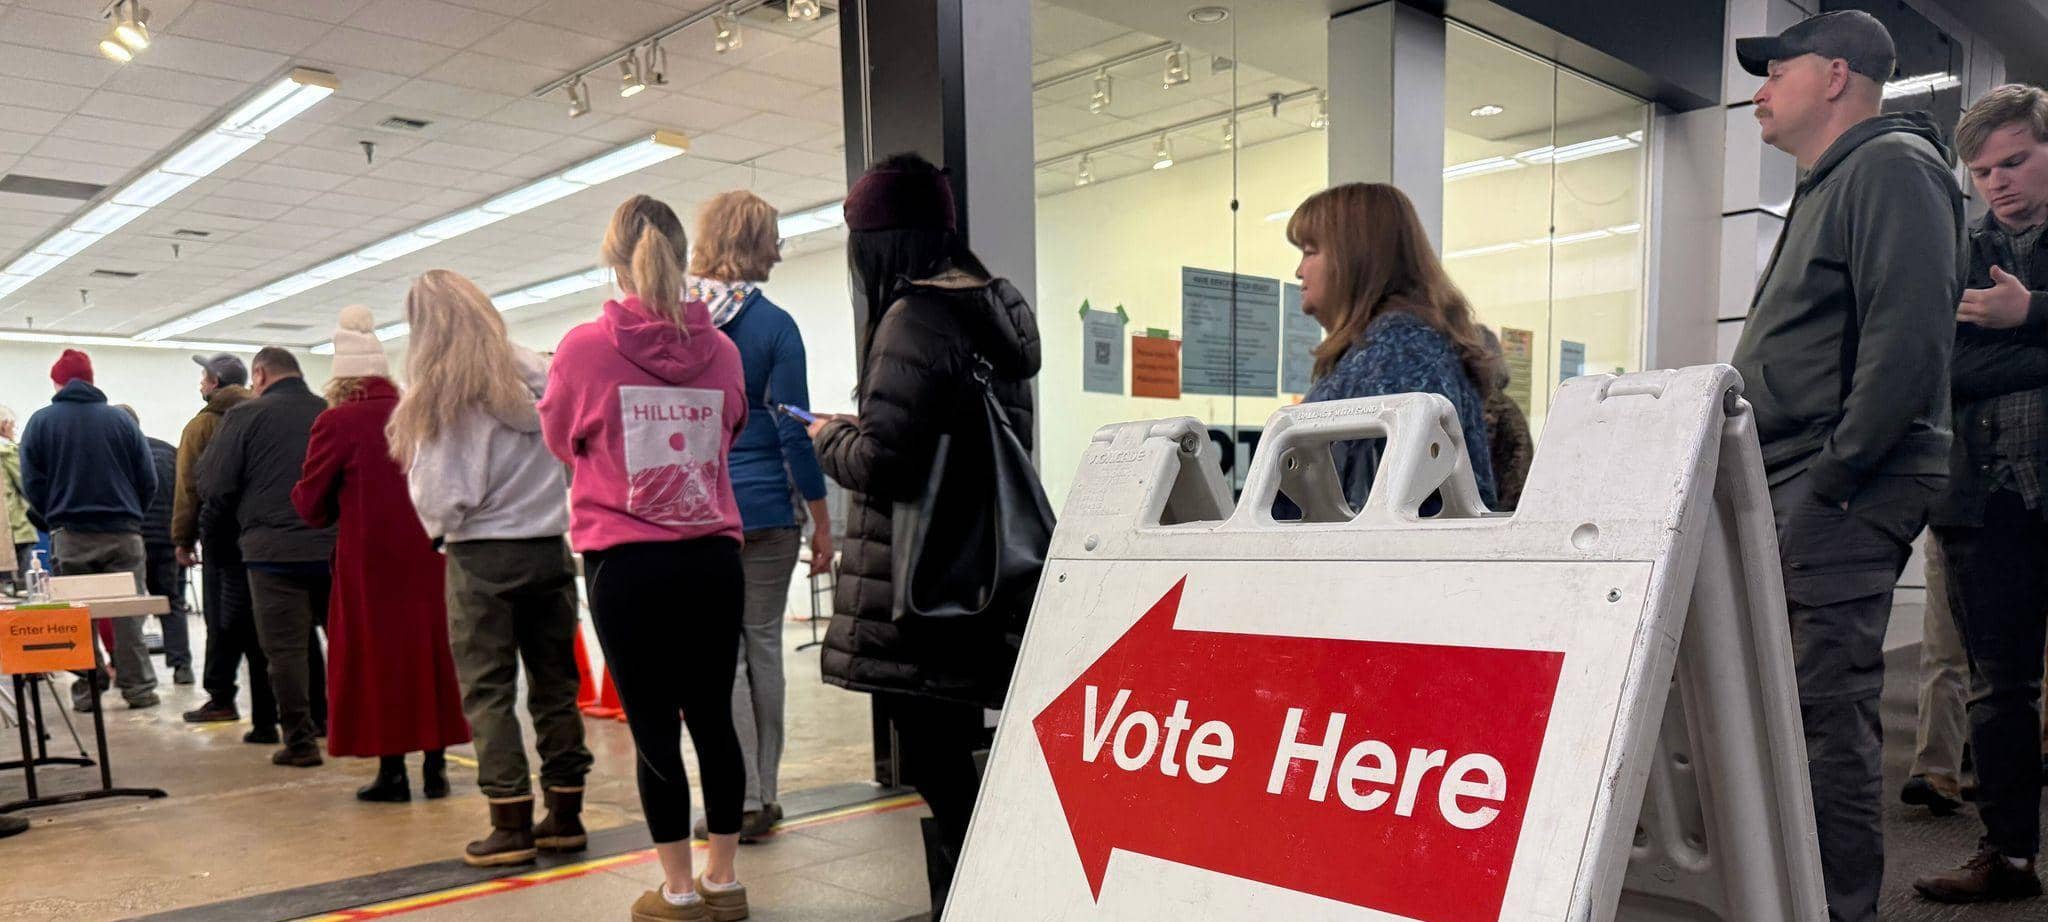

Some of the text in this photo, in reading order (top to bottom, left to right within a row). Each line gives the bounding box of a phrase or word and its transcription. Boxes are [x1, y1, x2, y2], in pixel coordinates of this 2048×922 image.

[10, 623, 78, 636] Enter Here
[1082, 685, 1507, 830] Vote Here
